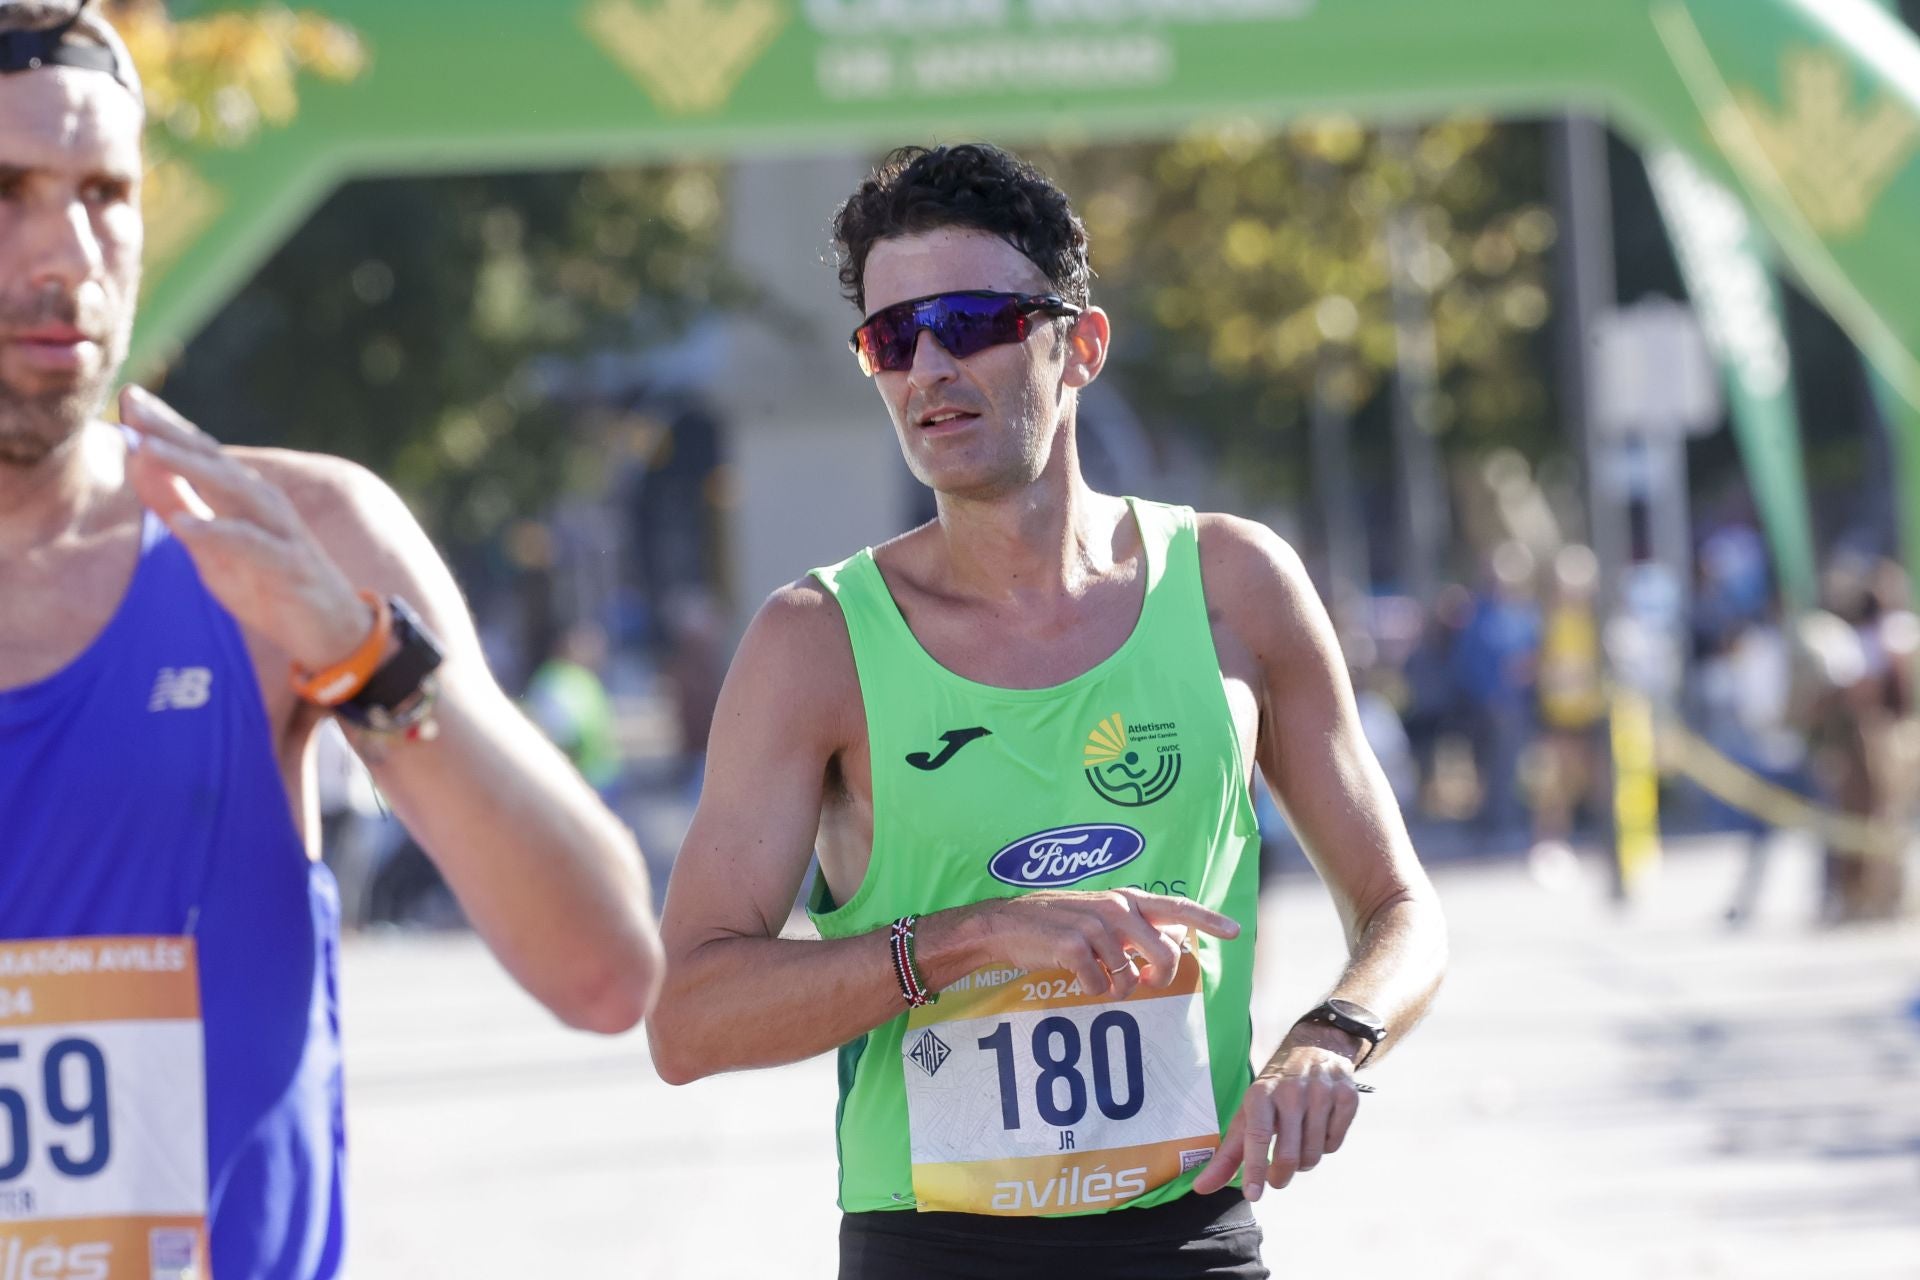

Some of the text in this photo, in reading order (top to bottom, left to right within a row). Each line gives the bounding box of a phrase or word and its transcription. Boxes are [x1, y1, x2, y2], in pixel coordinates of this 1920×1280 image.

[1128, 722, 1176, 734] Atletismo
[1157, 744, 1180, 753] CAVDC
[1022, 834, 1112, 880] Ford
[0, 938, 187, 977] RATÓN AVILÉS
[1022, 979, 1083, 1001] 2024
[977, 1010, 1145, 1131] 180
[1058, 1130, 1076, 1151] JR
[991, 1165, 1148, 1210] avilés
